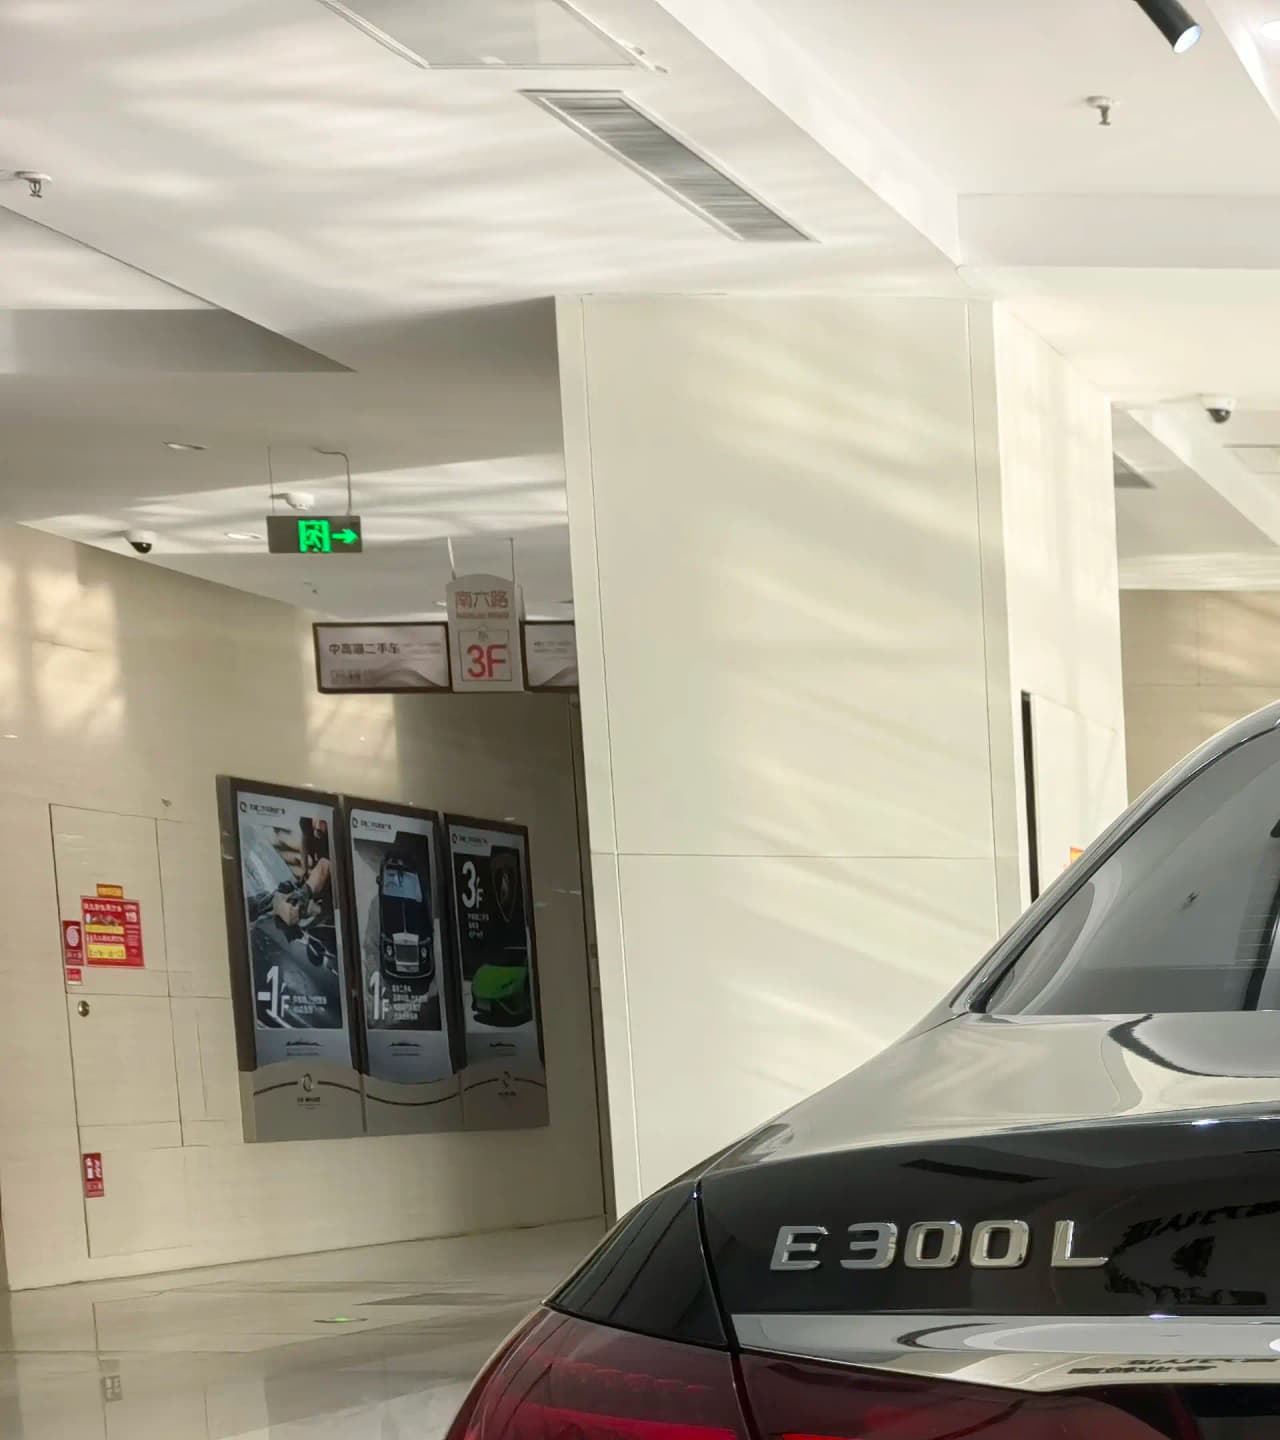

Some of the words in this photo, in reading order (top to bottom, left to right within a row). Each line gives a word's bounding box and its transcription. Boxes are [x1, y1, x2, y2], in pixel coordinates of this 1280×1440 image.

[466, 643, 508, 678] 3F
[770, 1225, 829, 1271] E
[840, 1219, 1029, 1269] 300
[1051, 1219, 1109, 1268] L
